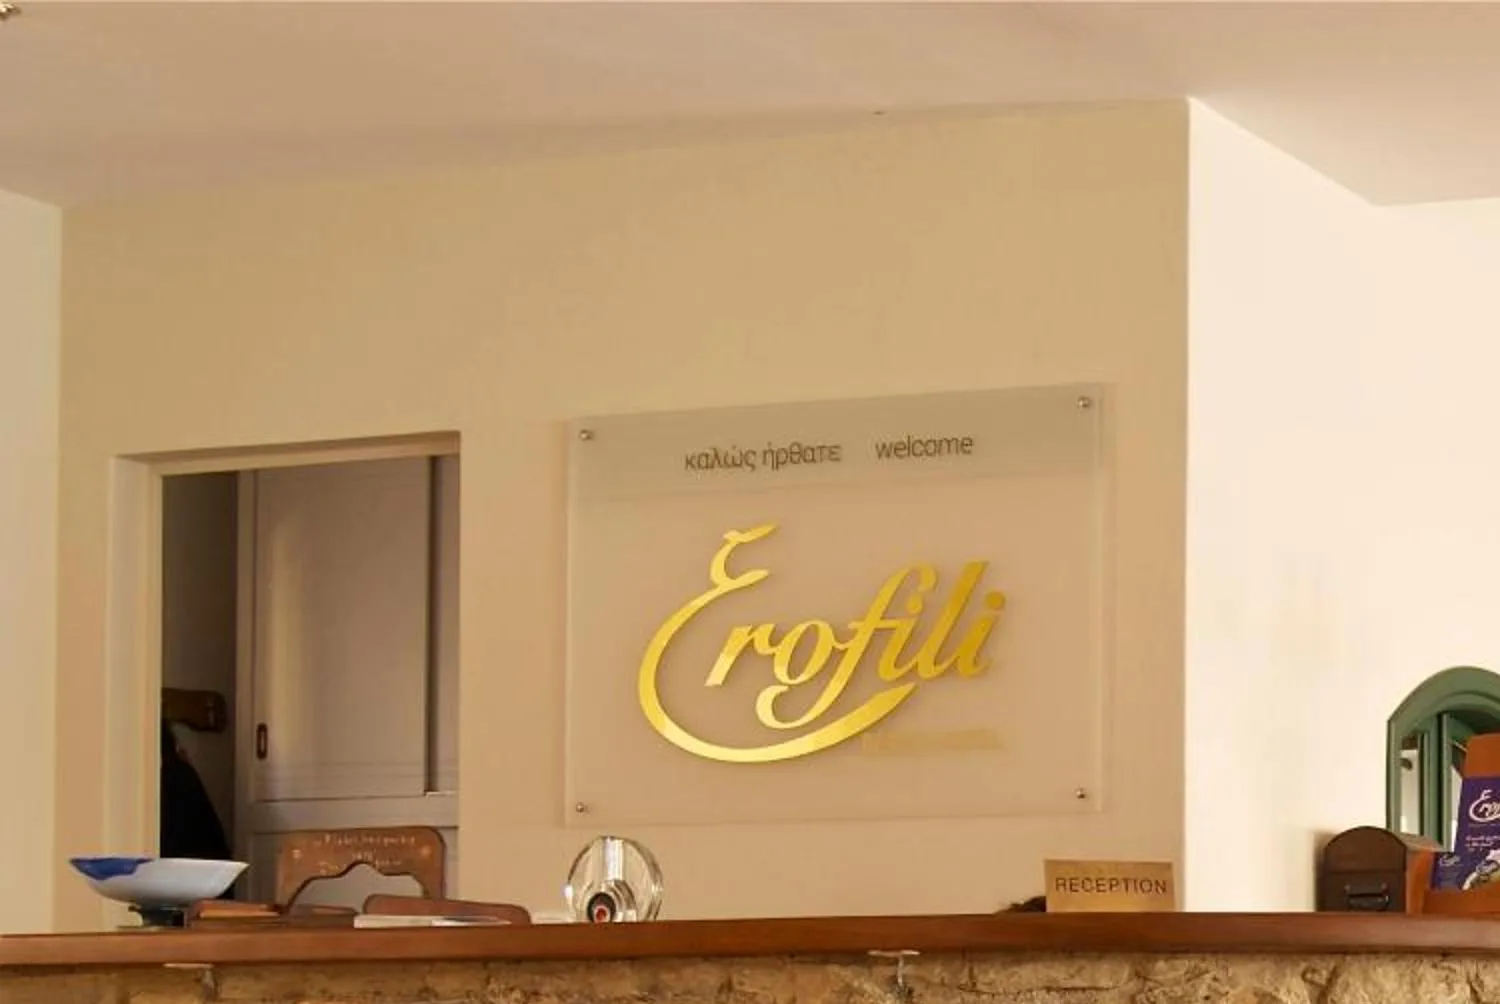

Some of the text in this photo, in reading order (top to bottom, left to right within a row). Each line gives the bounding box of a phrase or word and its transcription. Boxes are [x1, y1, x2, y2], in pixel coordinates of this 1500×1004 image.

[683, 434, 975, 472] καλώς ήρθατε welcome
[638, 522, 1006, 763] Erofili
[1055, 876, 1168, 894] RECEPTION
